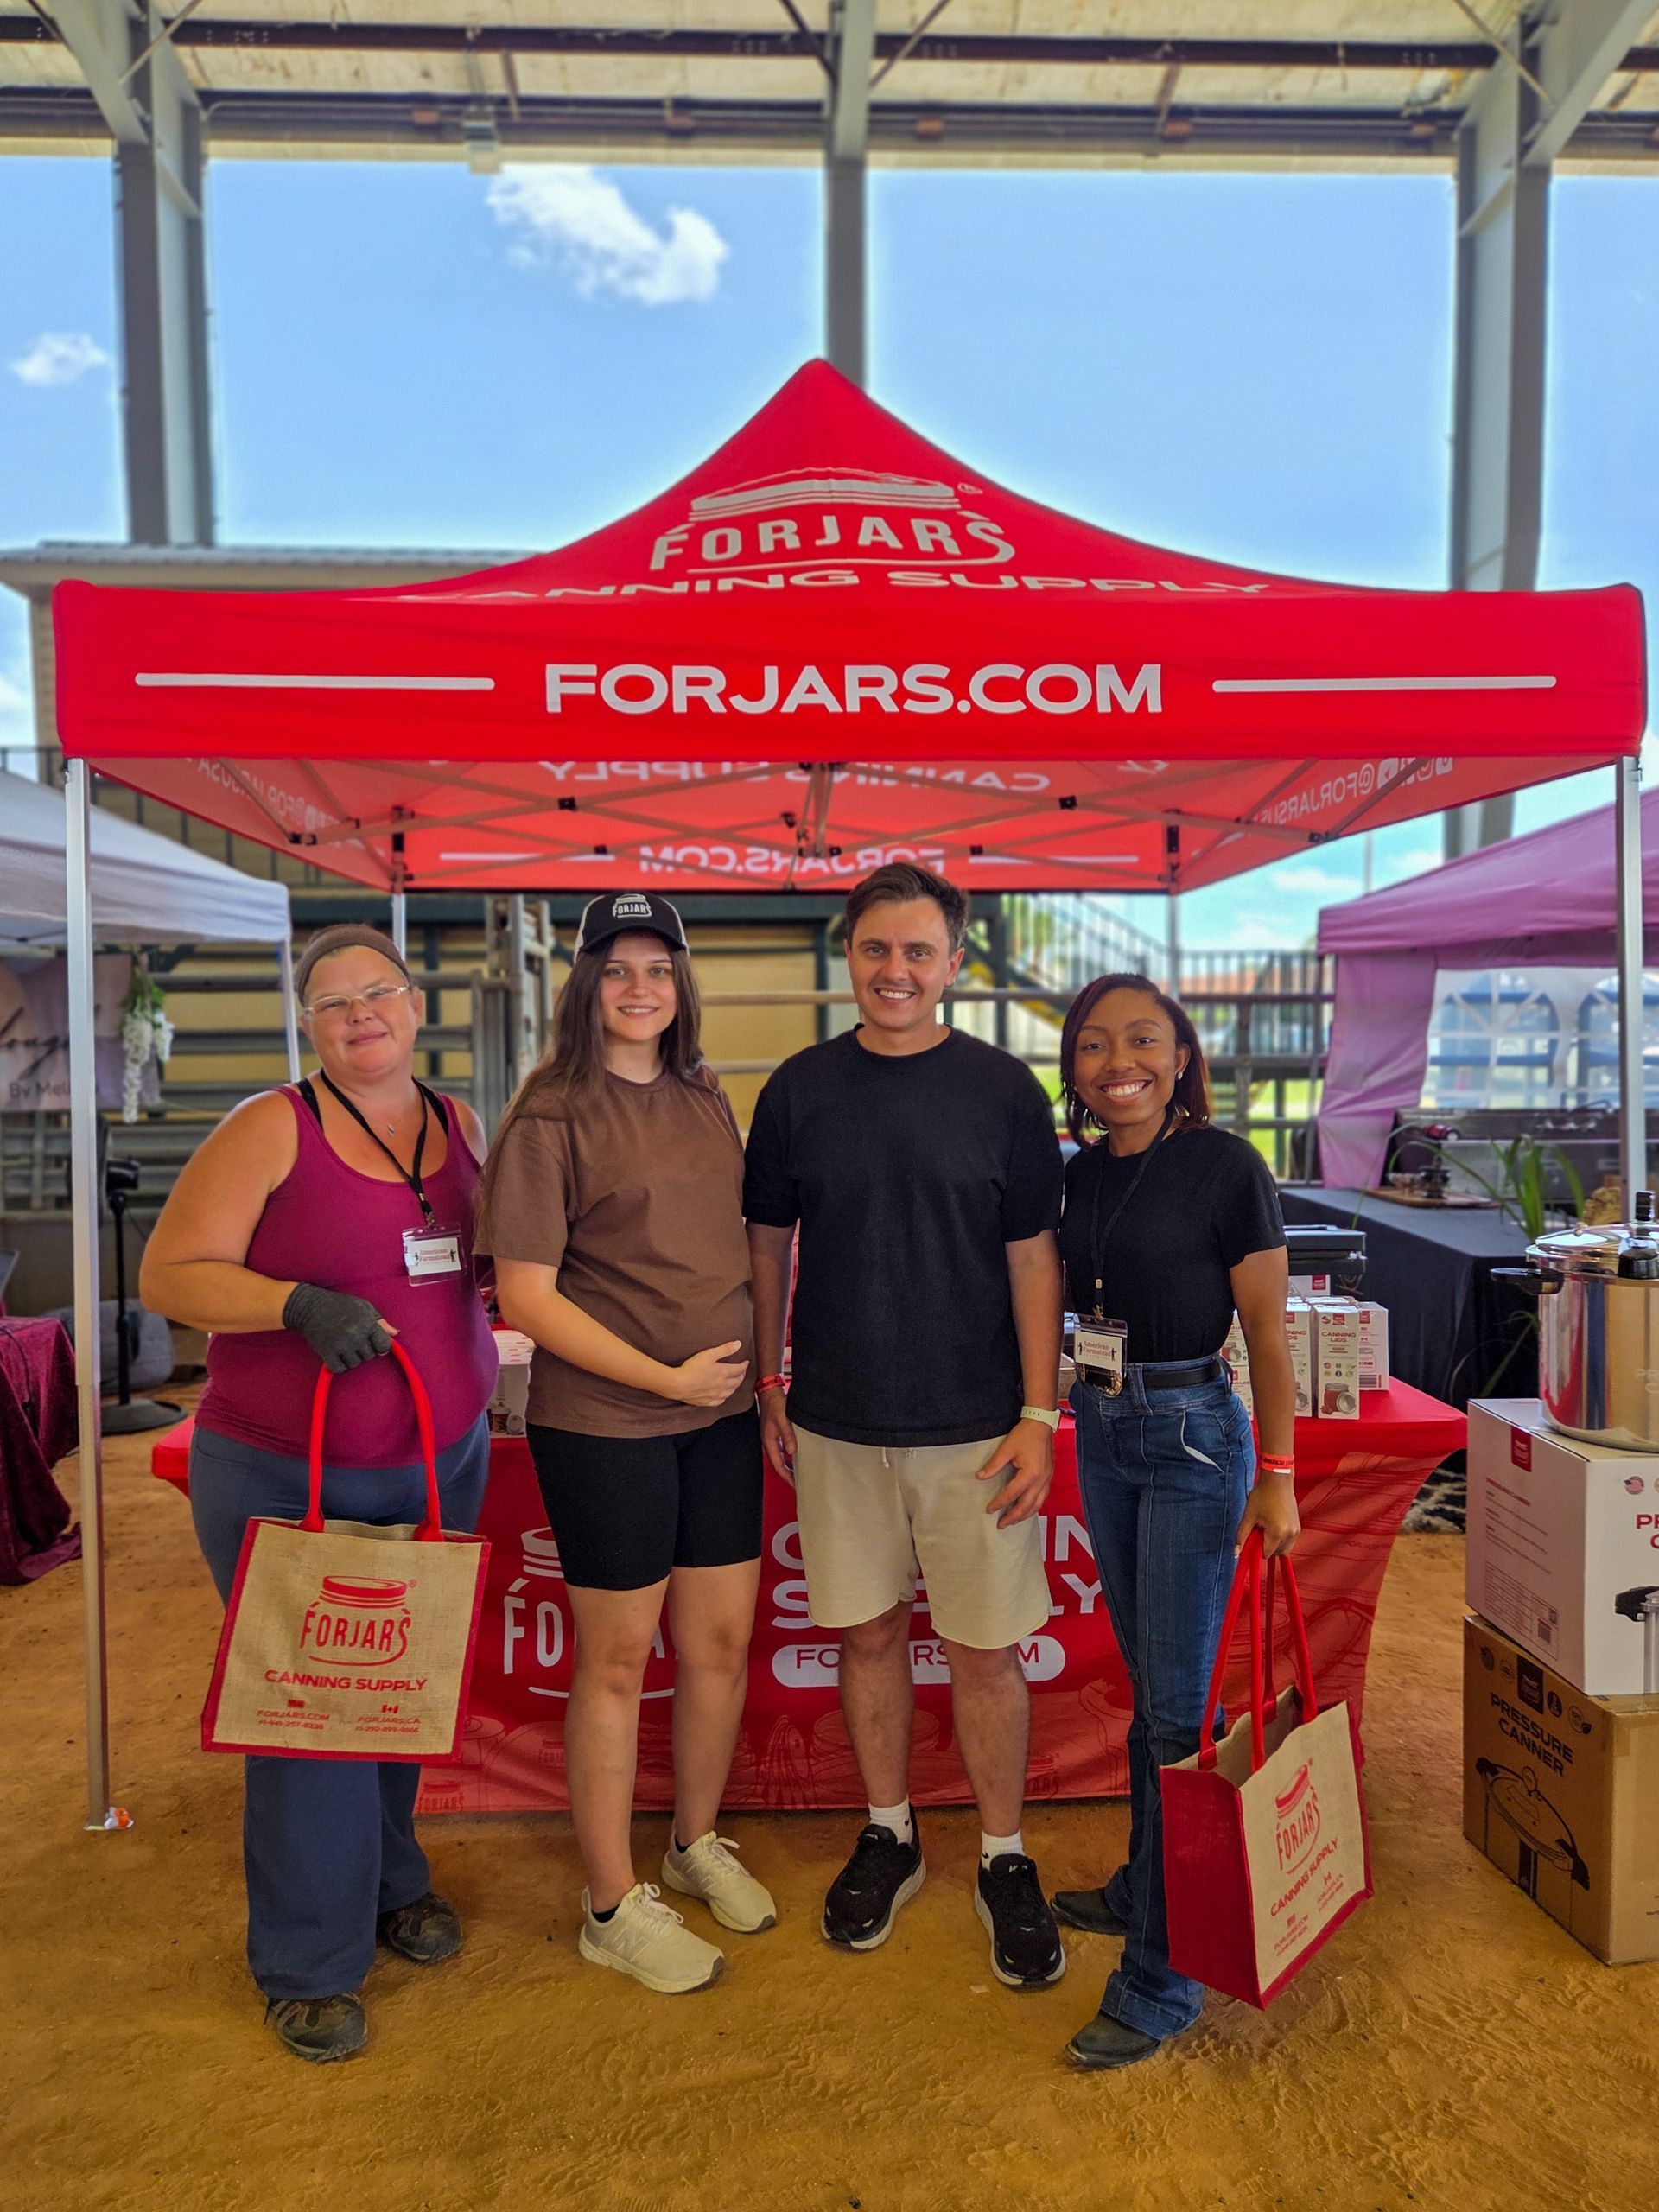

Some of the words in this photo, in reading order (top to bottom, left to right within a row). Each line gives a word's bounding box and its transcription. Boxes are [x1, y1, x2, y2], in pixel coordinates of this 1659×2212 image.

[650, 512, 1014, 572] FORJARS
[887, 571, 1269, 594] SUPPLY
[545, 663, 1163, 714] FORJARS.COM
[613, 901, 652, 918] FORJARS
[300, 1605, 411, 1661] FORJARS
[264, 1669, 353, 1690] CANNING
[355, 1678, 428, 1692] SUPPLY
[1491, 1693, 1573, 1764] PRESSURE
[1498, 1718, 1564, 1777] CANNER
[1276, 1789, 1319, 1871] FORJARS
[1270, 1871, 1309, 1916] CANNING
[1310, 1838, 1338, 1877] SUPPLY
